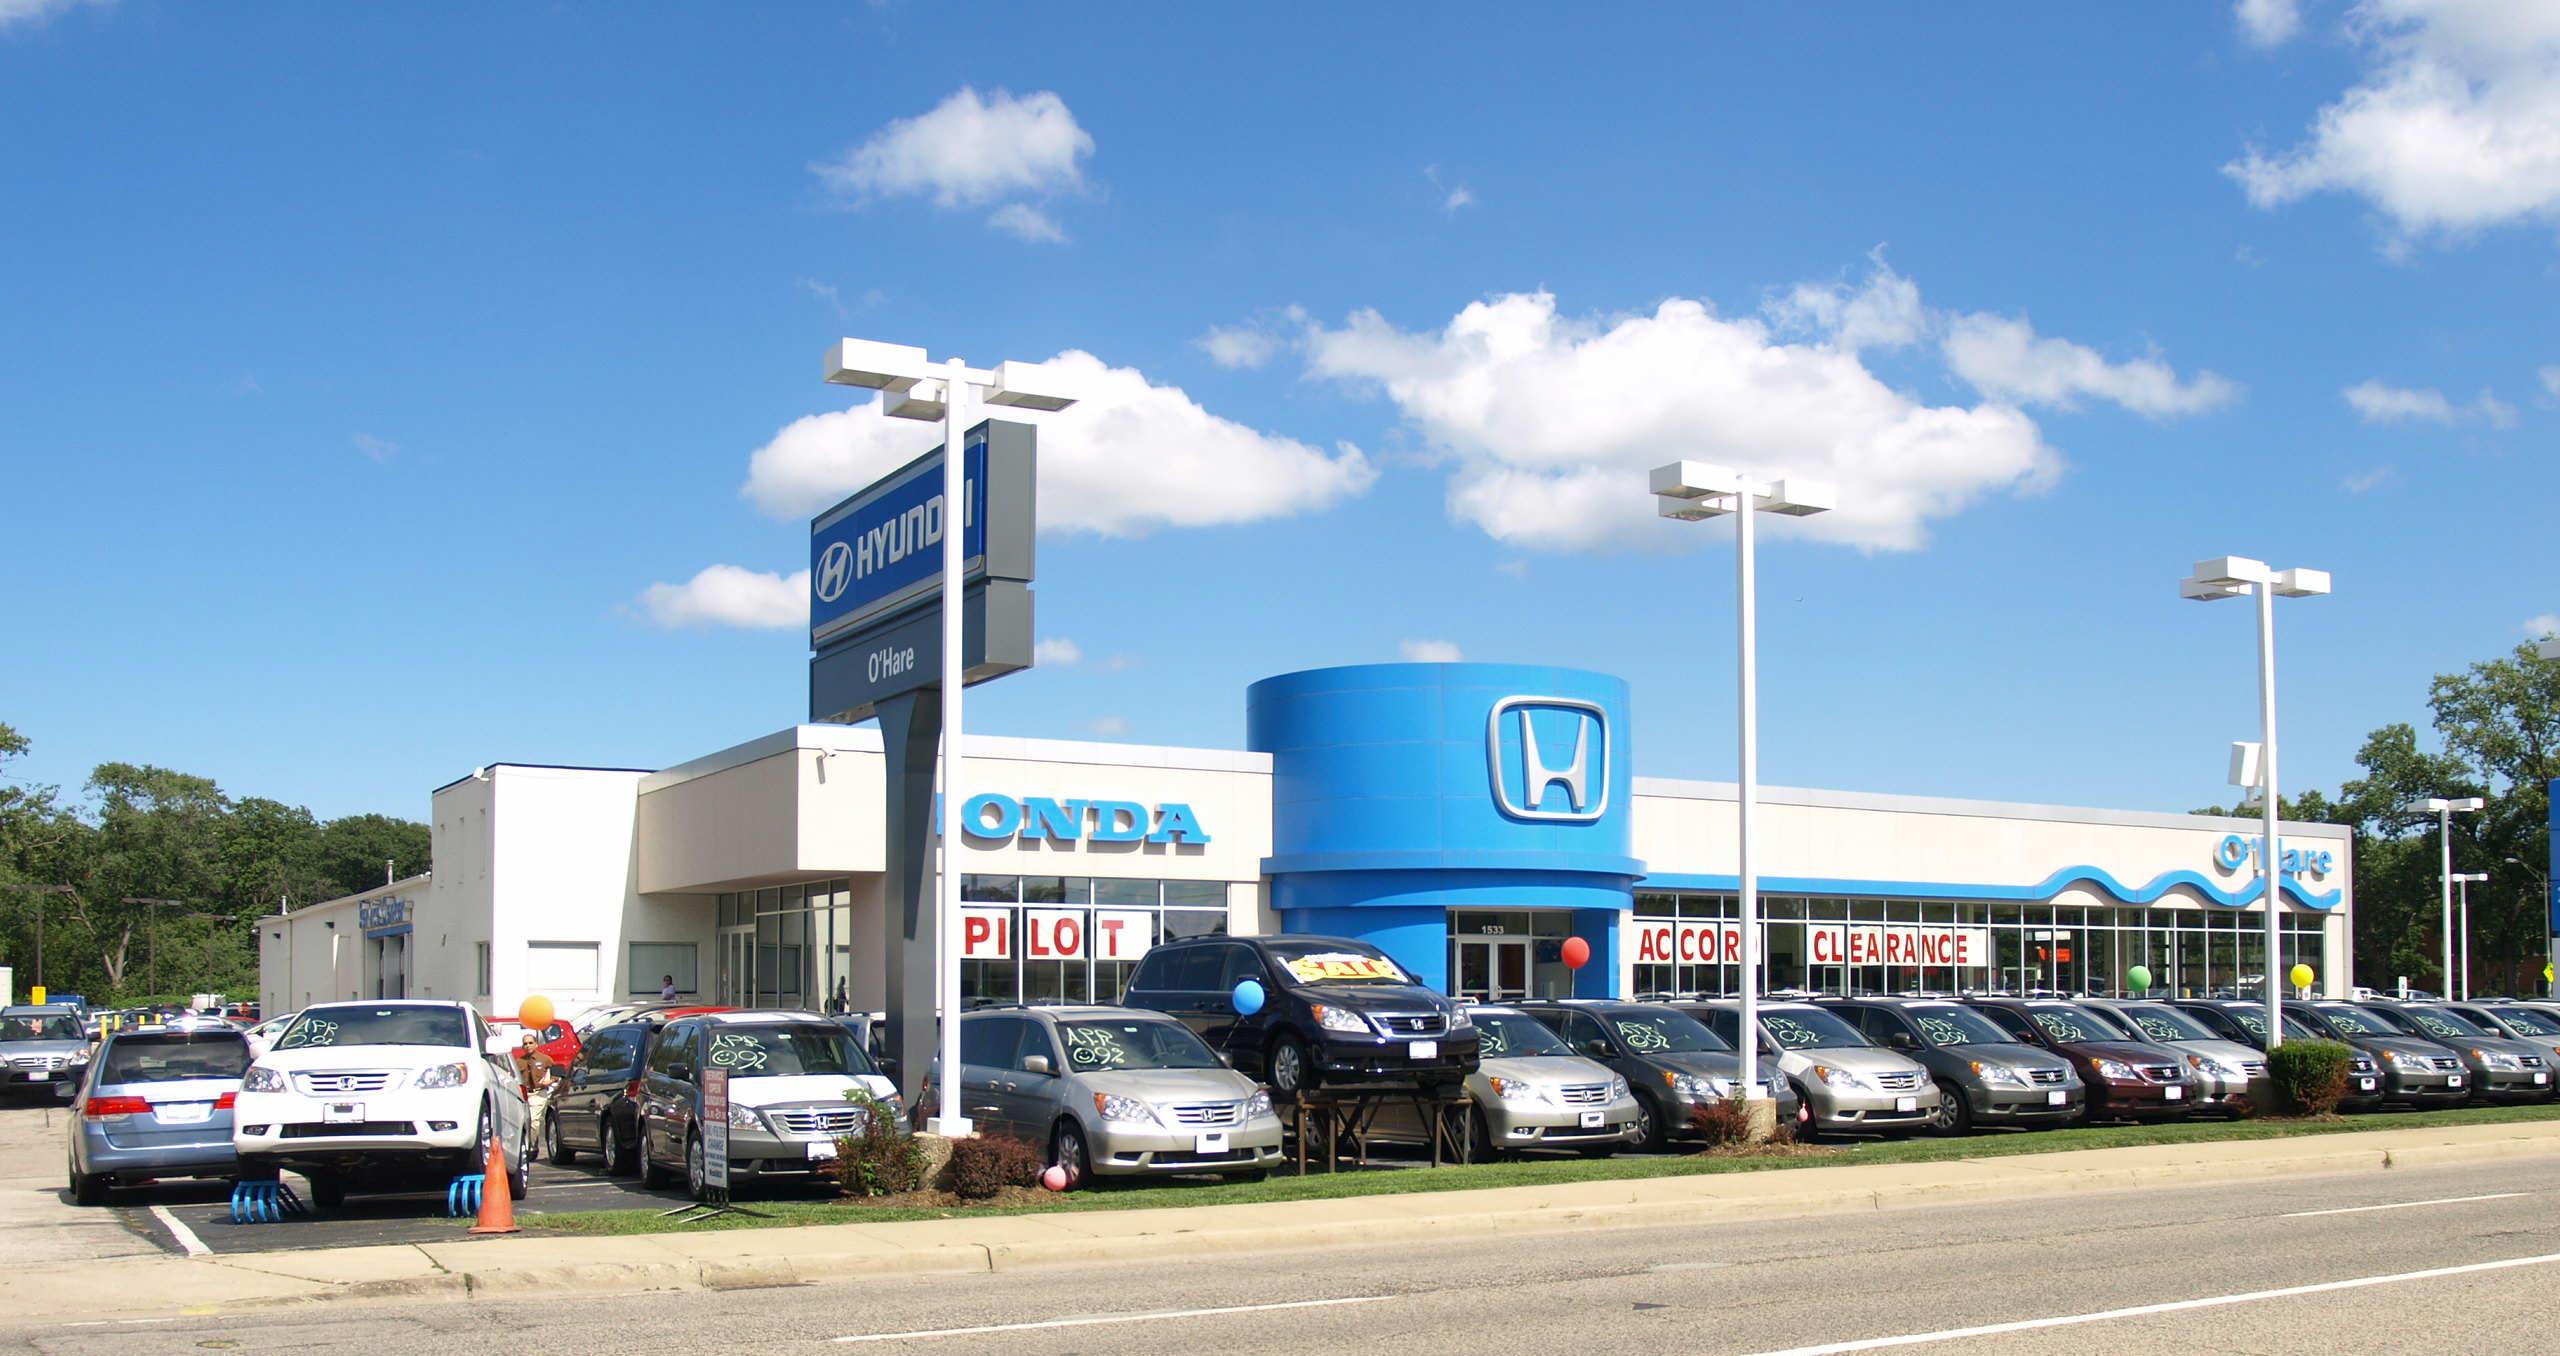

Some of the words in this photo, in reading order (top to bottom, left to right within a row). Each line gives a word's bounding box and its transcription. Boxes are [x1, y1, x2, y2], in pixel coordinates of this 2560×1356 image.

[856, 478, 974, 580] HYUNDI
[868, 647, 914, 683] O'Hare
[936, 793, 1211, 843] ONDA
[965, 917, 1124, 957] PILOT
[1481, 925, 1504, 935] 1533
[1638, 928, 1758, 962] ACCOR
[1813, 931, 1968, 964] CLEARANCE
